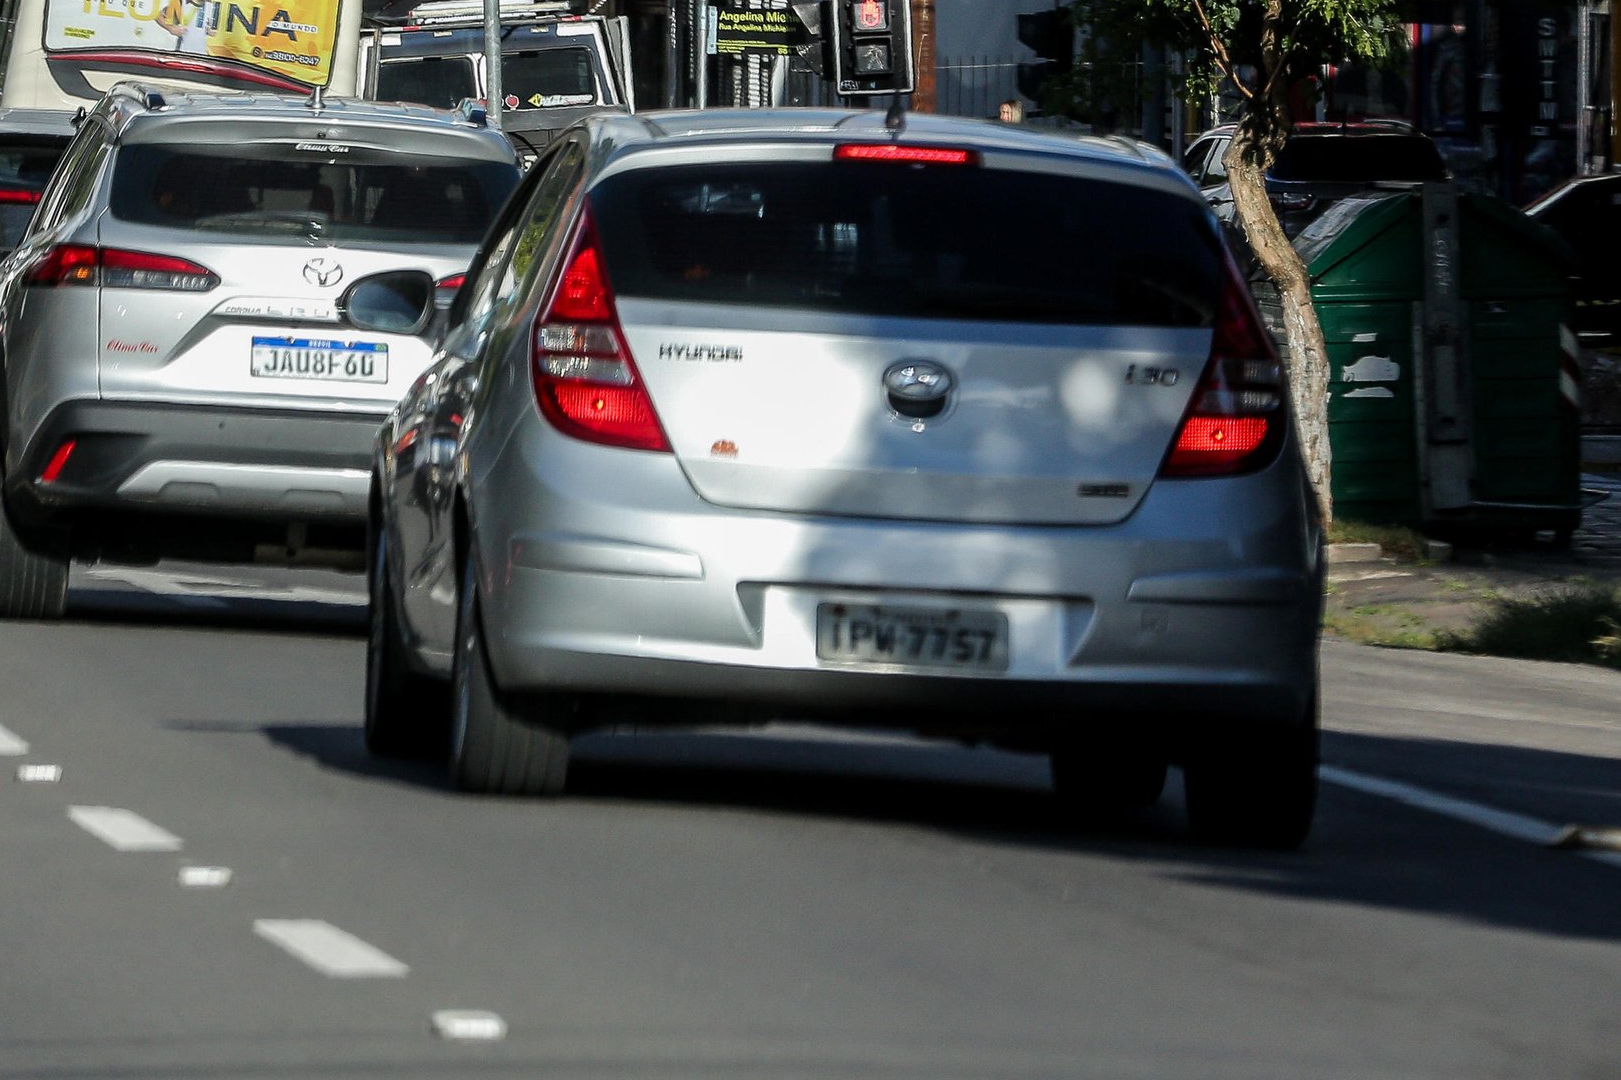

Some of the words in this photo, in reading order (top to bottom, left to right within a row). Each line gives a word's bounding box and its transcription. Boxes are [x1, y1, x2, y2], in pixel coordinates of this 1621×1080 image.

[719, 10, 764, 23] Angelina
[282, 22, 317, 33] MUNDO
[719, 22, 732, 31] Rua
[732, 23, 762, 33] Angelina
[658, 342, 743, 362] HYUNDAI
